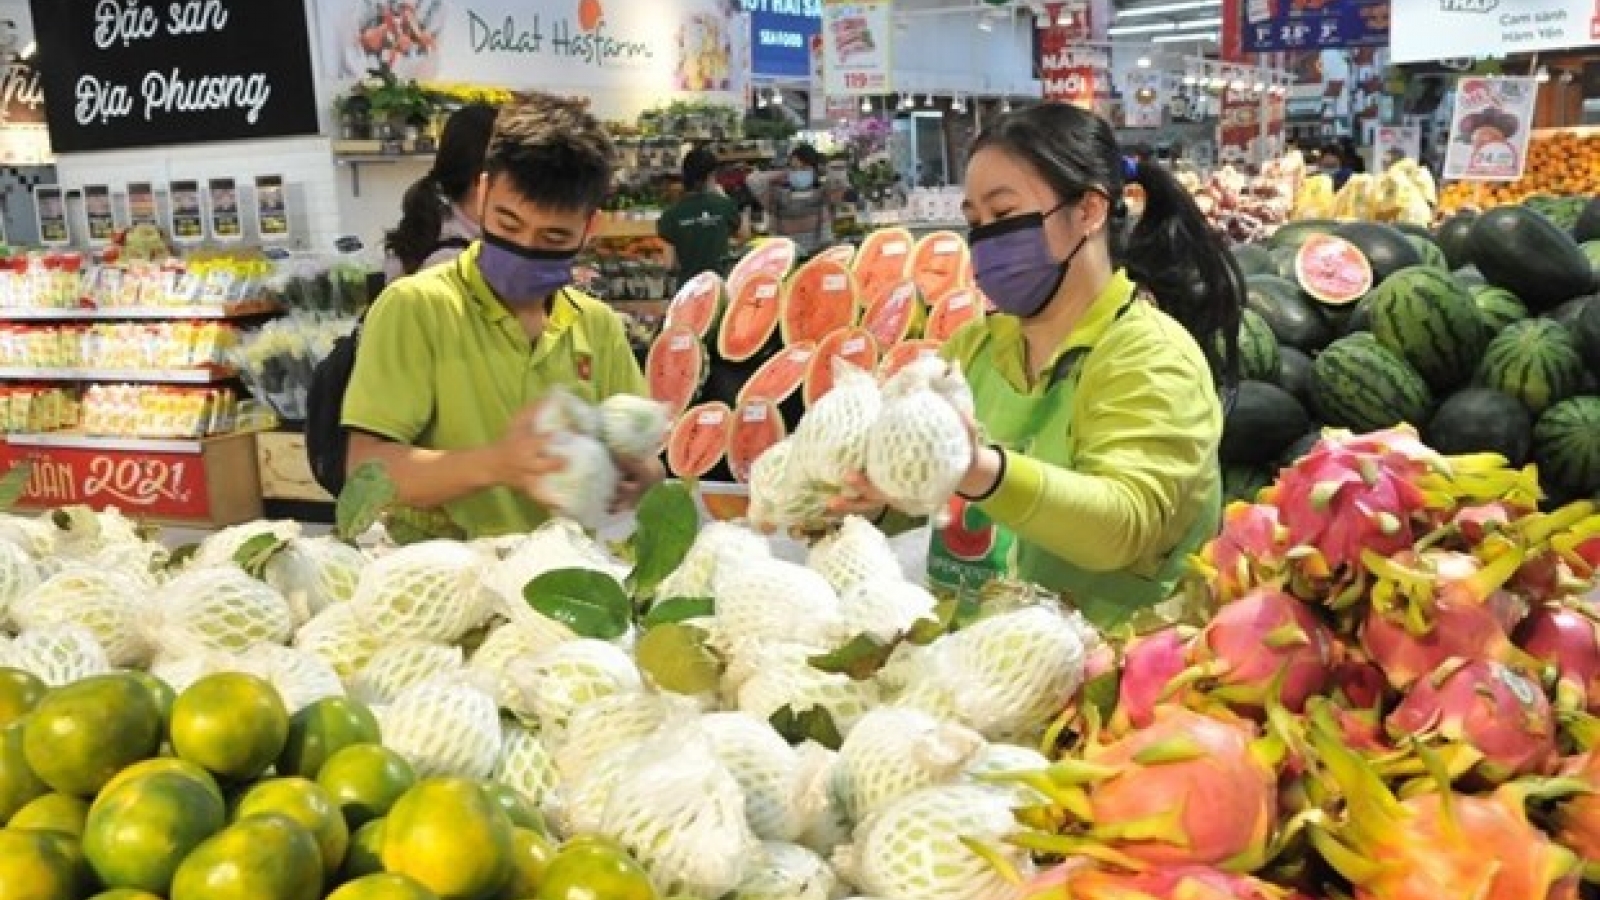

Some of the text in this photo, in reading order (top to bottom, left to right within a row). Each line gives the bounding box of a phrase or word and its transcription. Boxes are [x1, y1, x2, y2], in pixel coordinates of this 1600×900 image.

[467, 8, 543, 54] Dalat
[74, 67, 271, 126] Địa Phương
[82, 456, 191, 505] 2021
